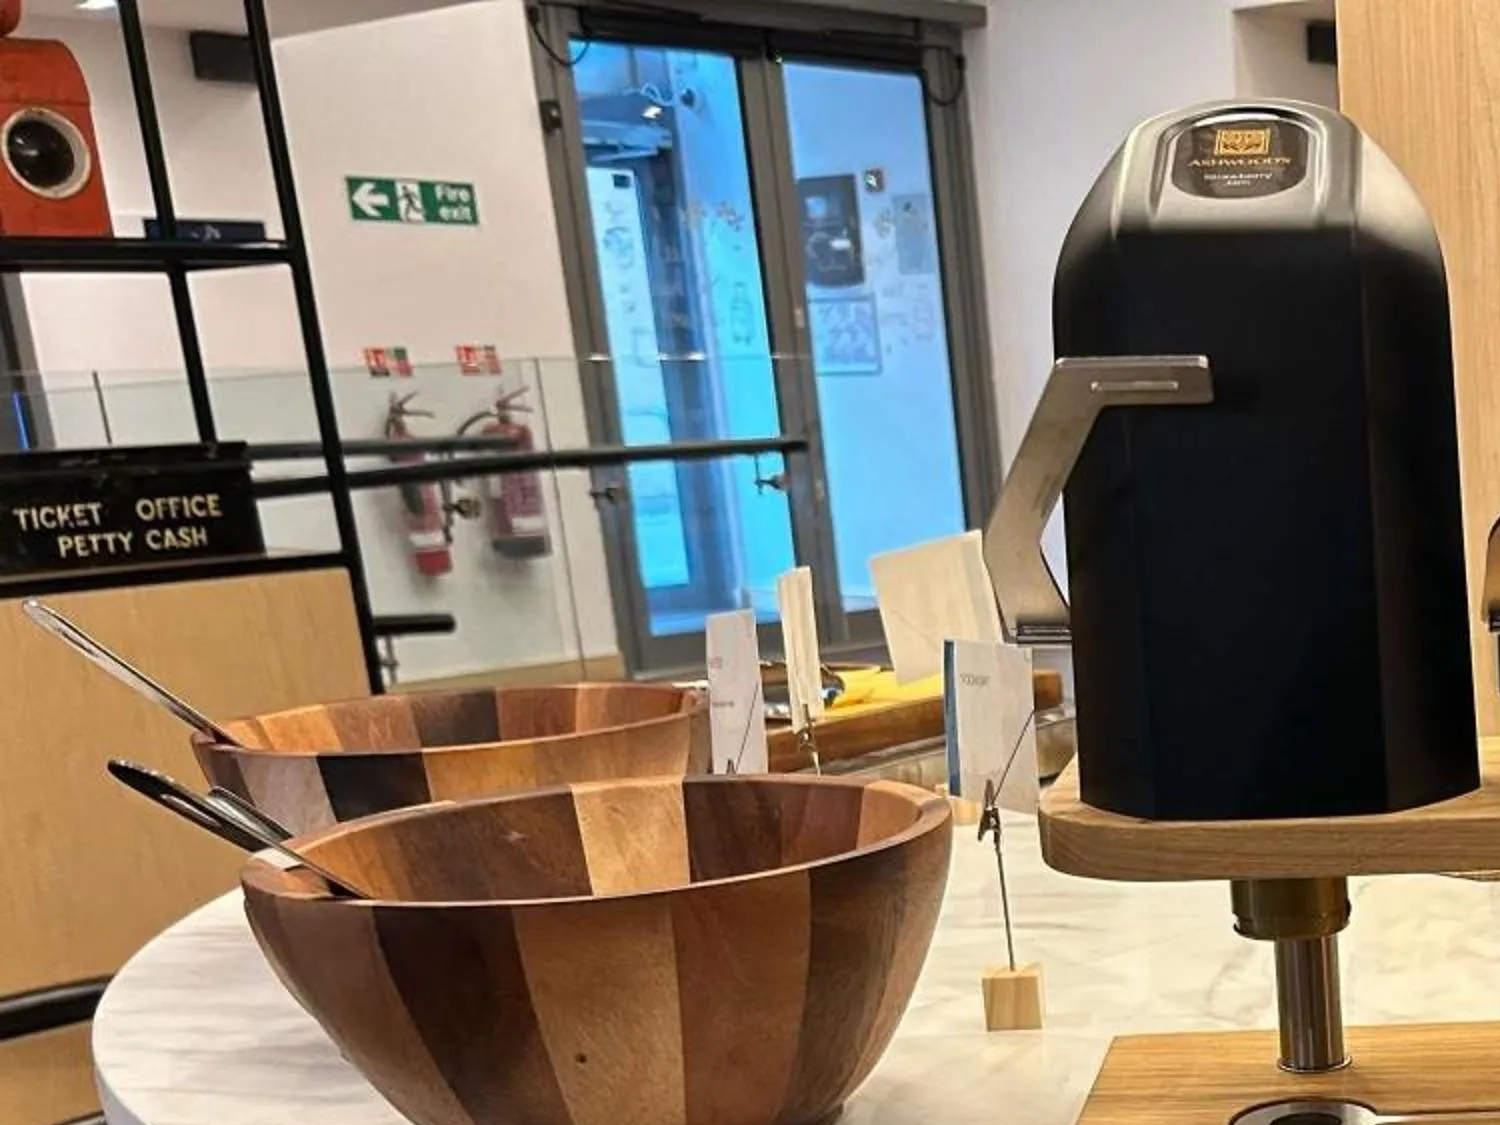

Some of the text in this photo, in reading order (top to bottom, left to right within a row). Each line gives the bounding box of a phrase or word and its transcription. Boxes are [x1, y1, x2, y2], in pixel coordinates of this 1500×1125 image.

[435, 184, 471, 202] Fire
[438, 204, 472, 221] exit
[12, 493, 224, 532] TICKET OFFICE
[57, 525, 209, 558] PETTY CASH
